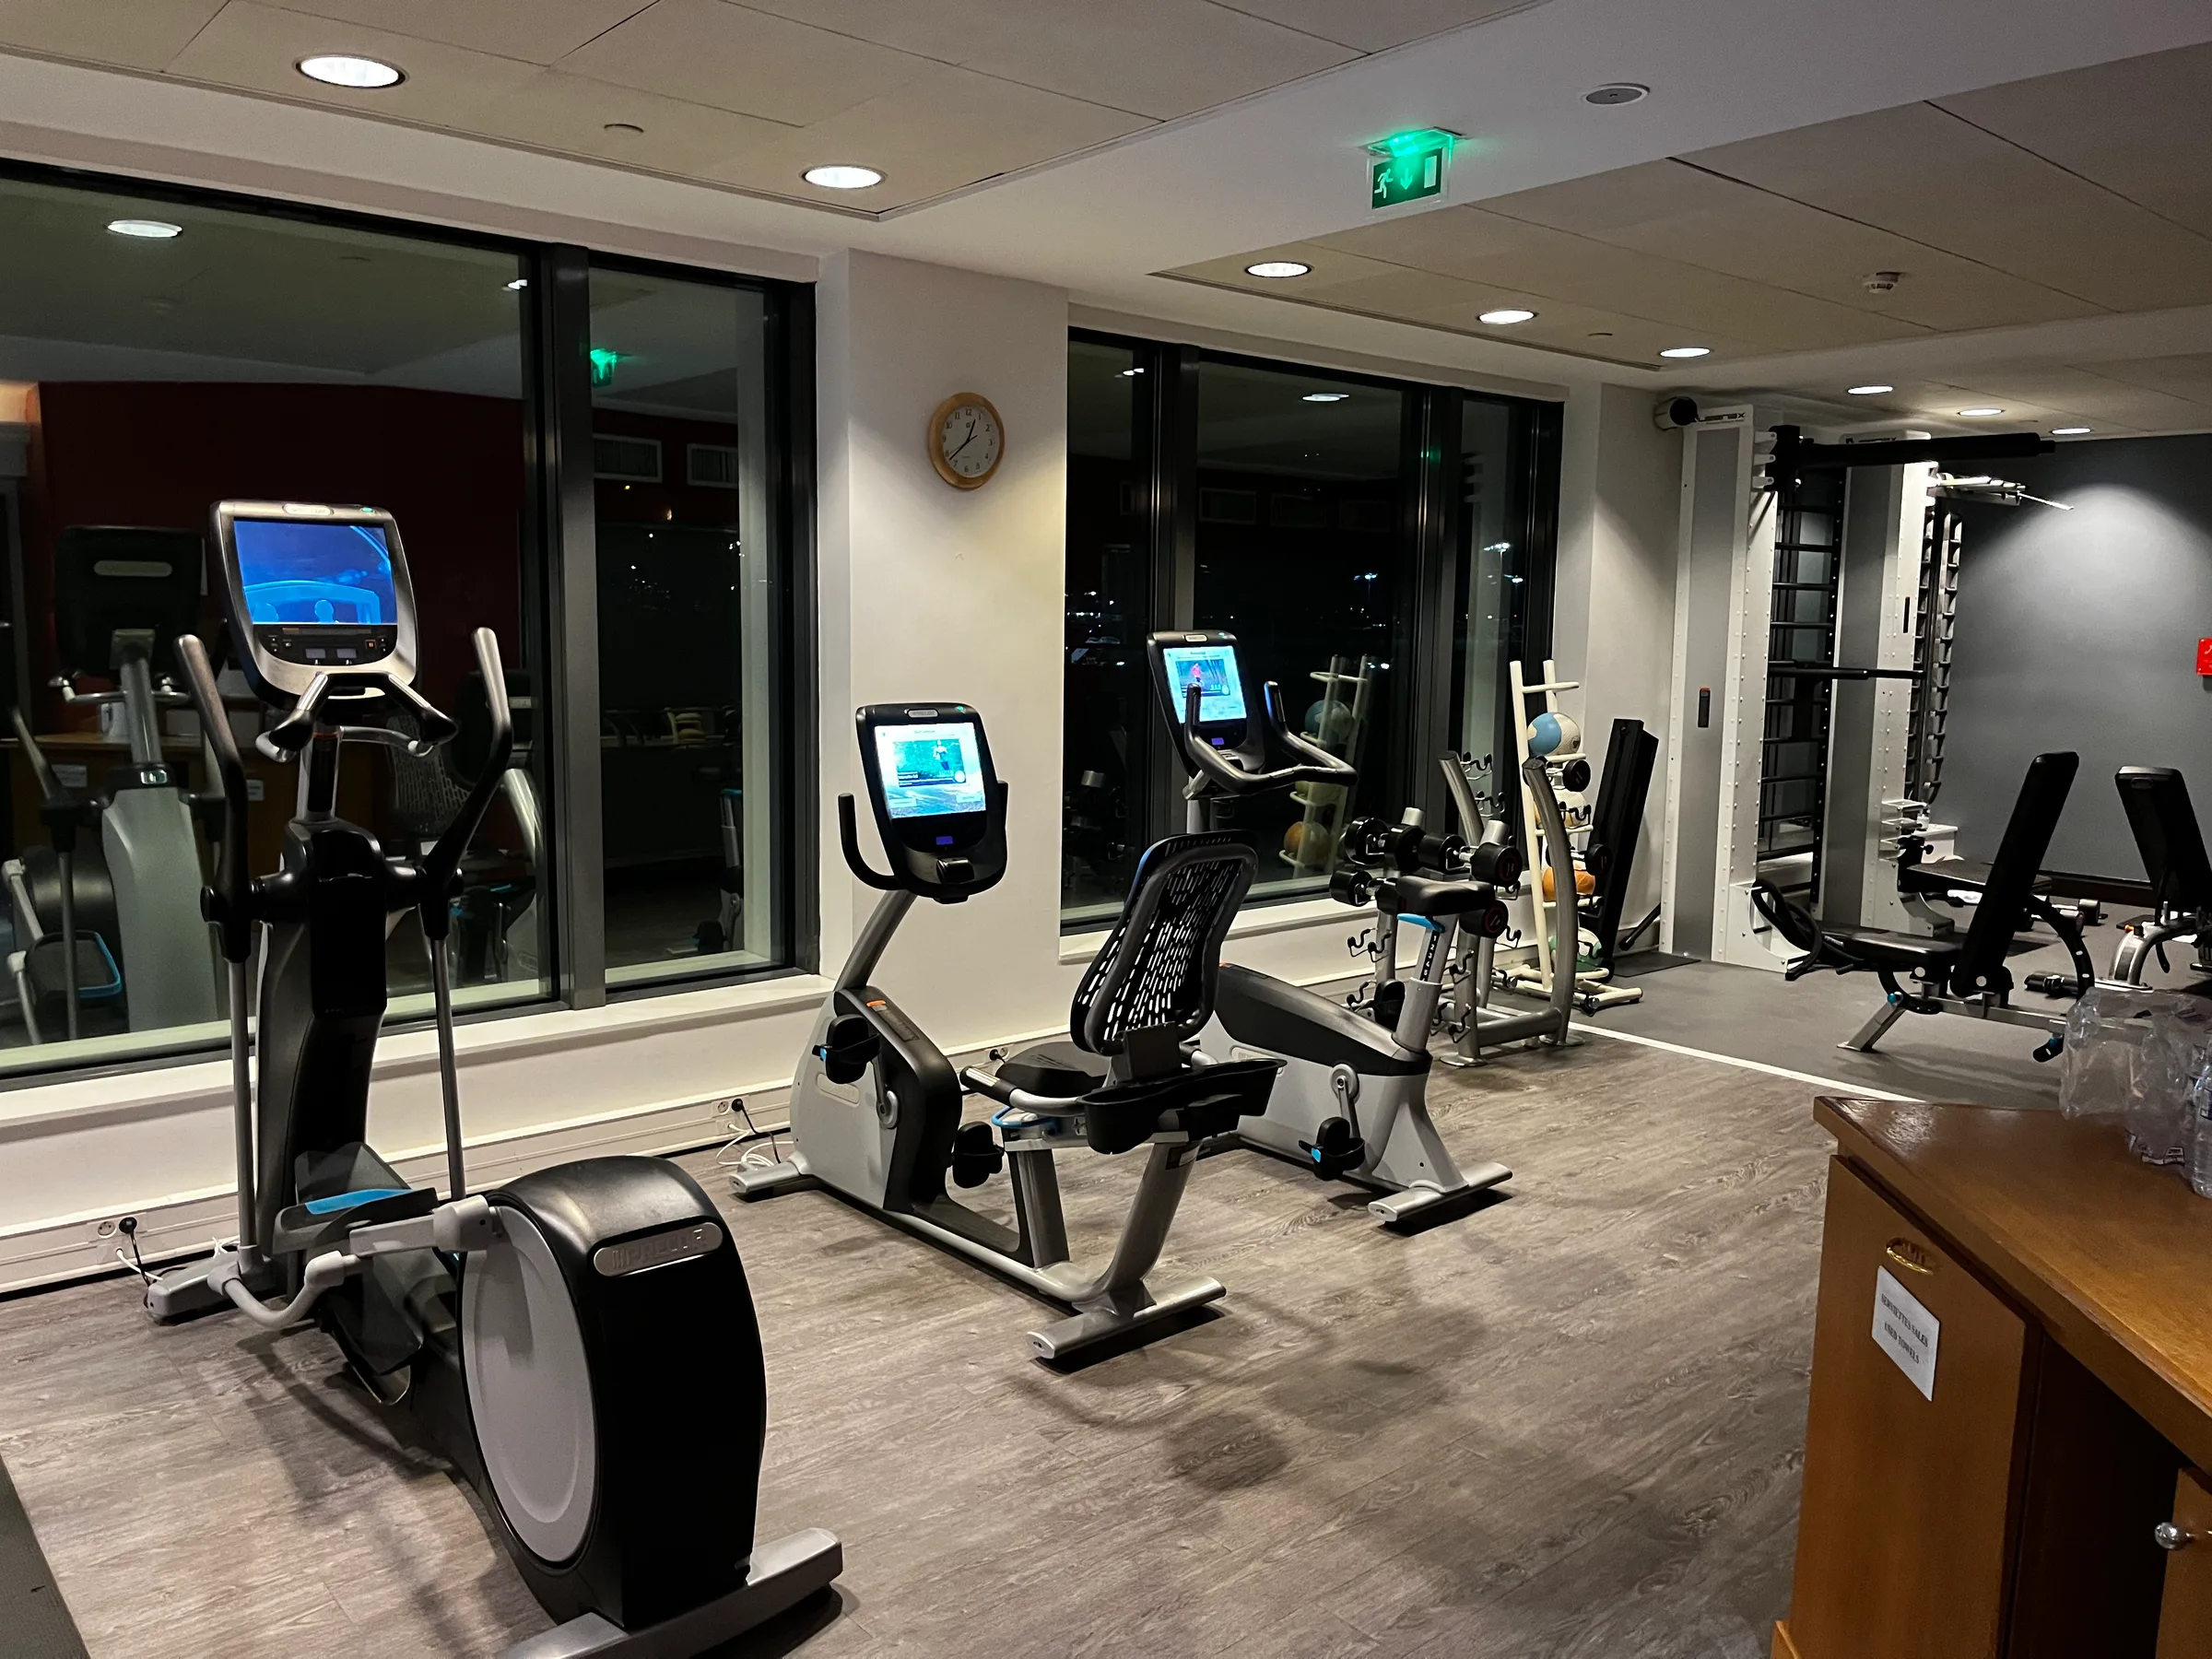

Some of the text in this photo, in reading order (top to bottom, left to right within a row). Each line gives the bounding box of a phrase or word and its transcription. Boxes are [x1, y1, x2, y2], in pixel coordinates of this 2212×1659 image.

[965, 408, 972, 417] 12
[946, 421, 953, 429] 10
[1884, 1322, 1920, 1364] USED TOWELS
[1912, 1324, 1928, 1347] SALES
